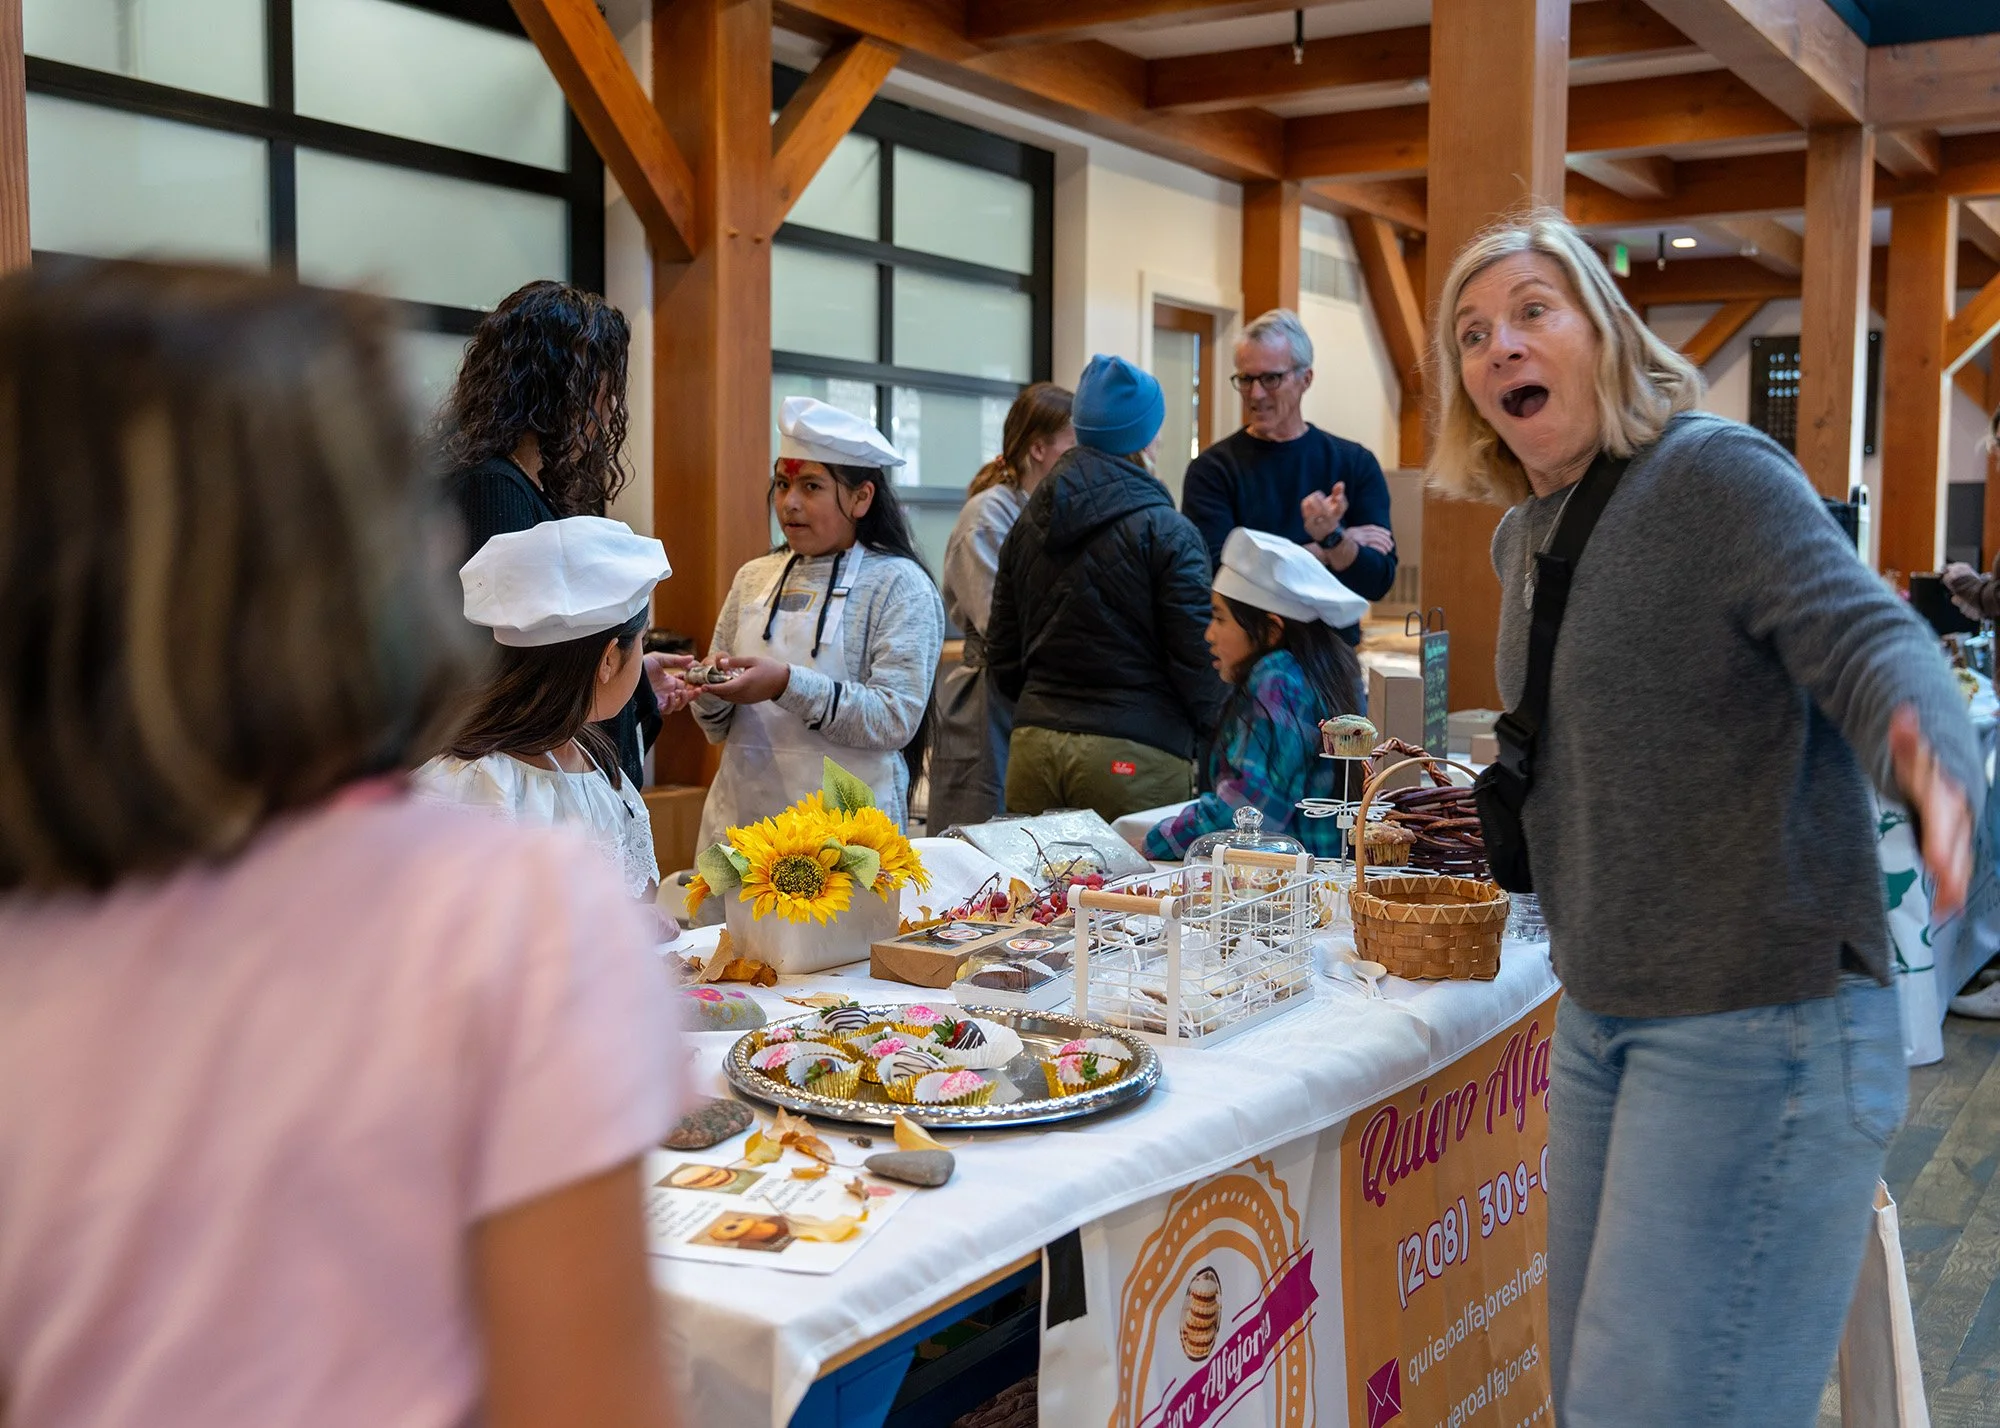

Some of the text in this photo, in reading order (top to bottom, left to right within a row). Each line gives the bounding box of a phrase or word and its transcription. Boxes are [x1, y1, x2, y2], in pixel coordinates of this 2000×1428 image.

[1360, 1019, 1550, 1207] Quiero Alfa
[1396, 1195, 1471, 1311] (208)
[1167, 1391, 1197, 1428] iero
